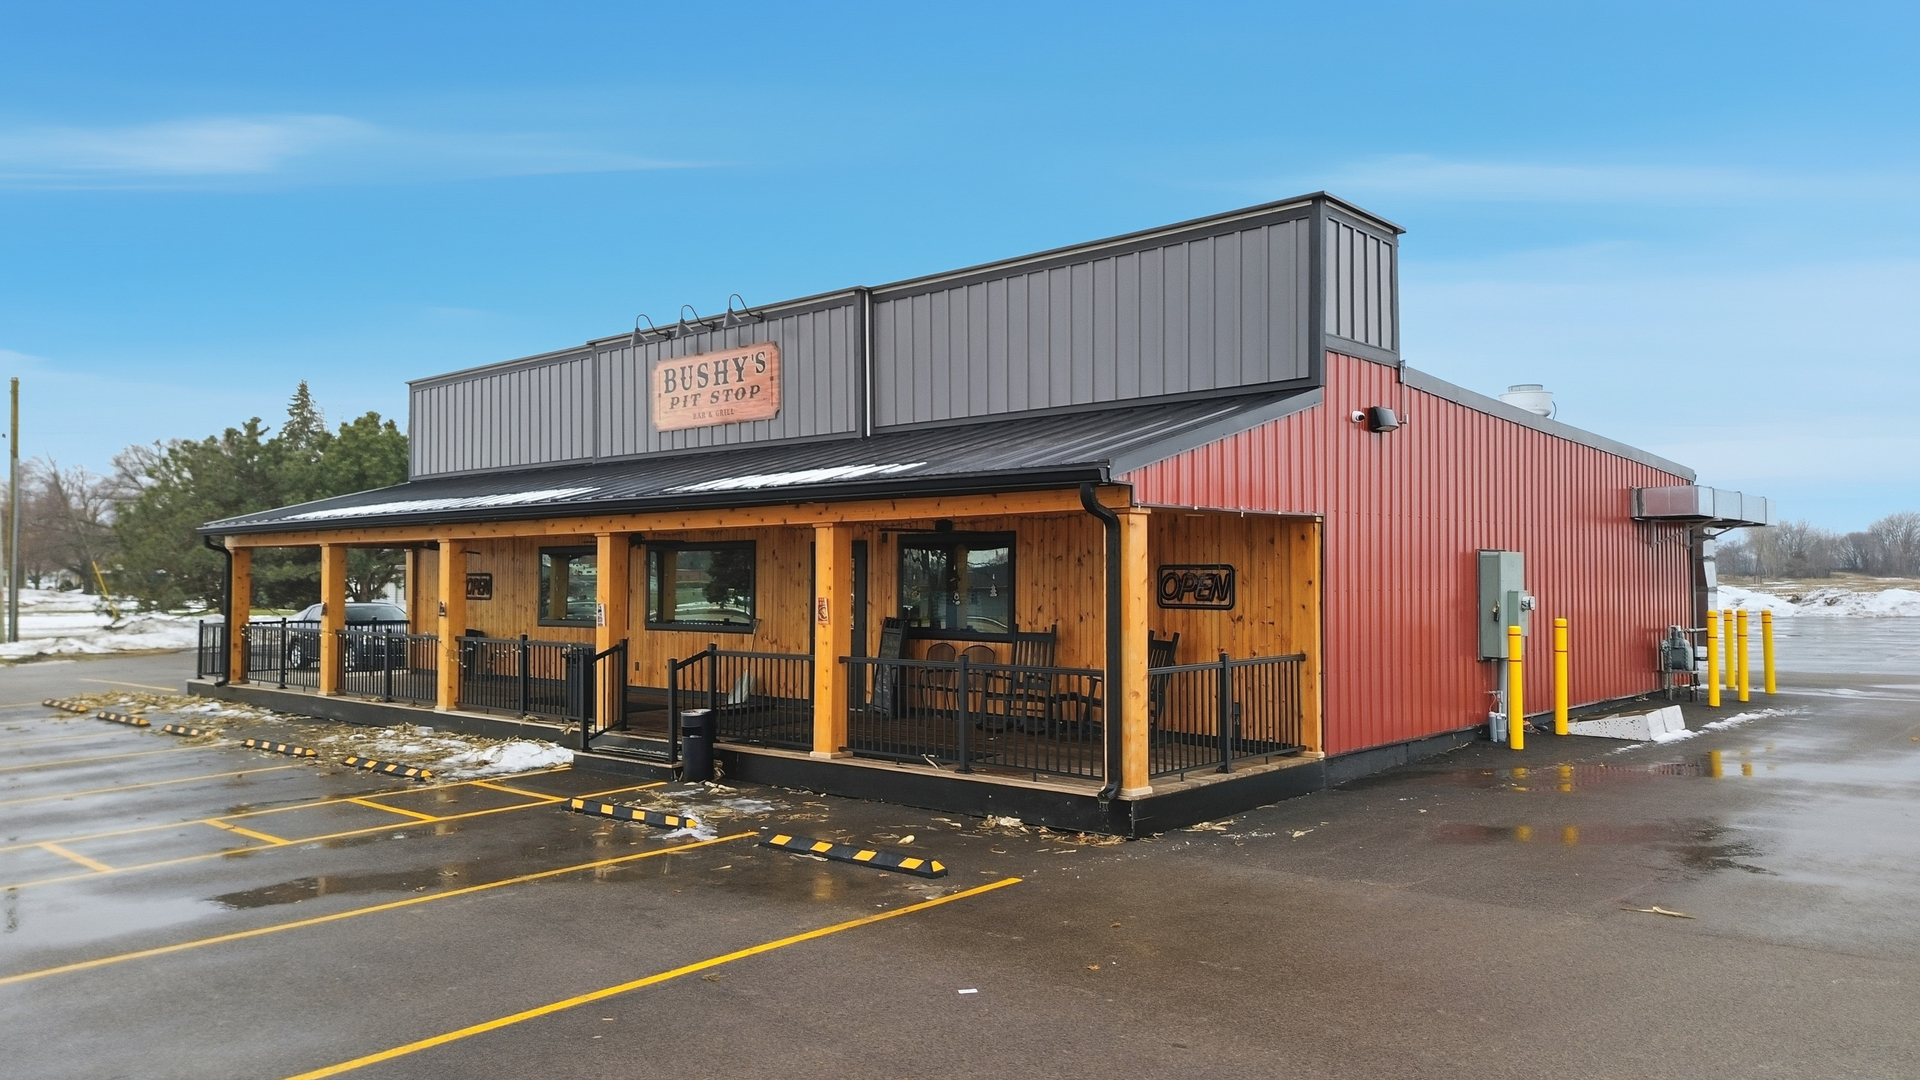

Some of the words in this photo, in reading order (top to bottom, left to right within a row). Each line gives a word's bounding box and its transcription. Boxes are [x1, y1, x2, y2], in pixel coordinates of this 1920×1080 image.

[664, 351, 766, 393] BUSHY'S
[669, 393, 702, 409] PIT
[710, 384, 760, 404] STOP
[693, 411, 706, 420] BAR
[715, 407, 735, 417] GRILL
[1161, 572, 1229, 602] OPEN
